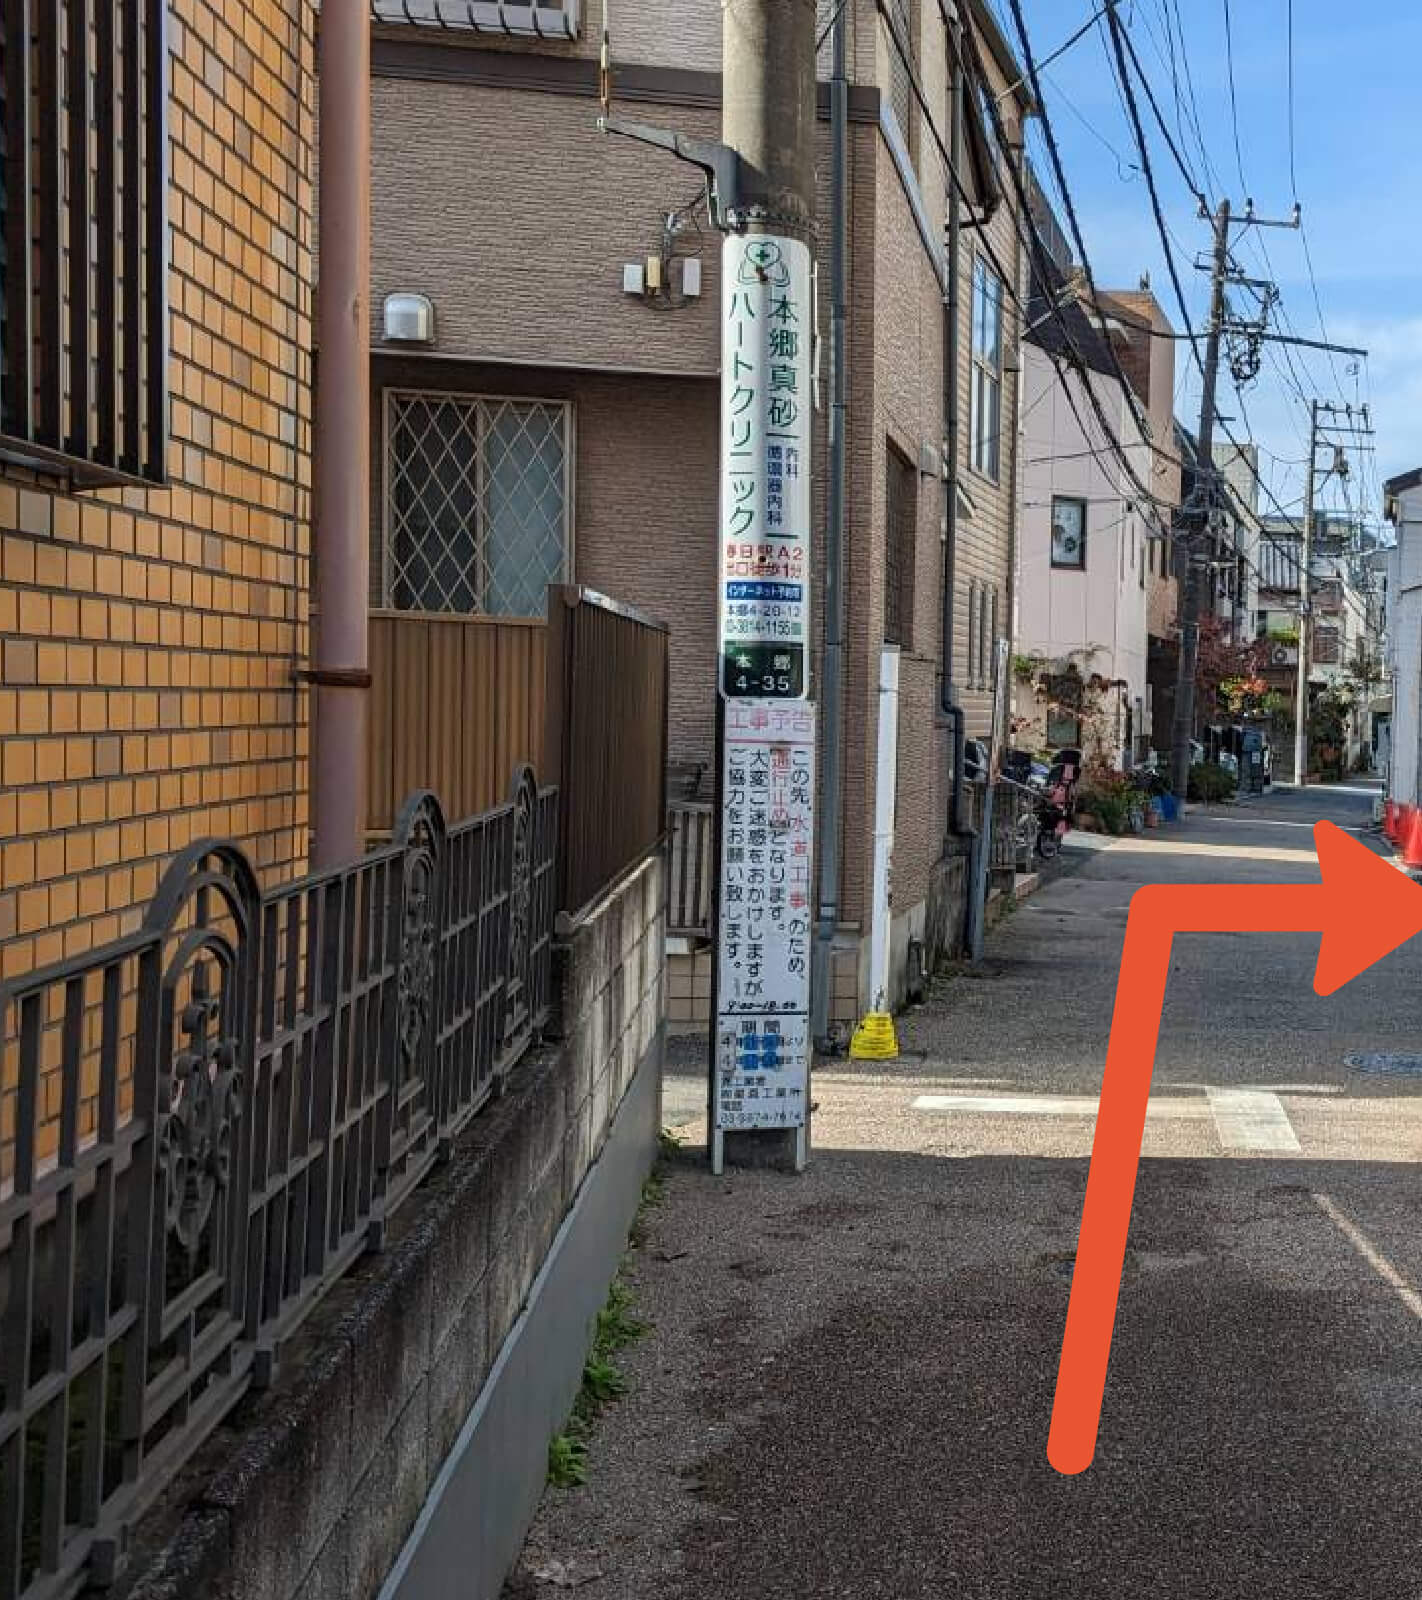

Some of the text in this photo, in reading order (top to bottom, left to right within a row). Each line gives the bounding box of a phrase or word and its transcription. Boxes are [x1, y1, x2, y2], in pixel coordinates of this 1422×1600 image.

[767, 294, 799, 427] 本郷真砂
[728, 292, 755, 536] ハートクリニック
[727, 708, 813, 733] 工事予告
[735, 675, 790, 691] 4-35
